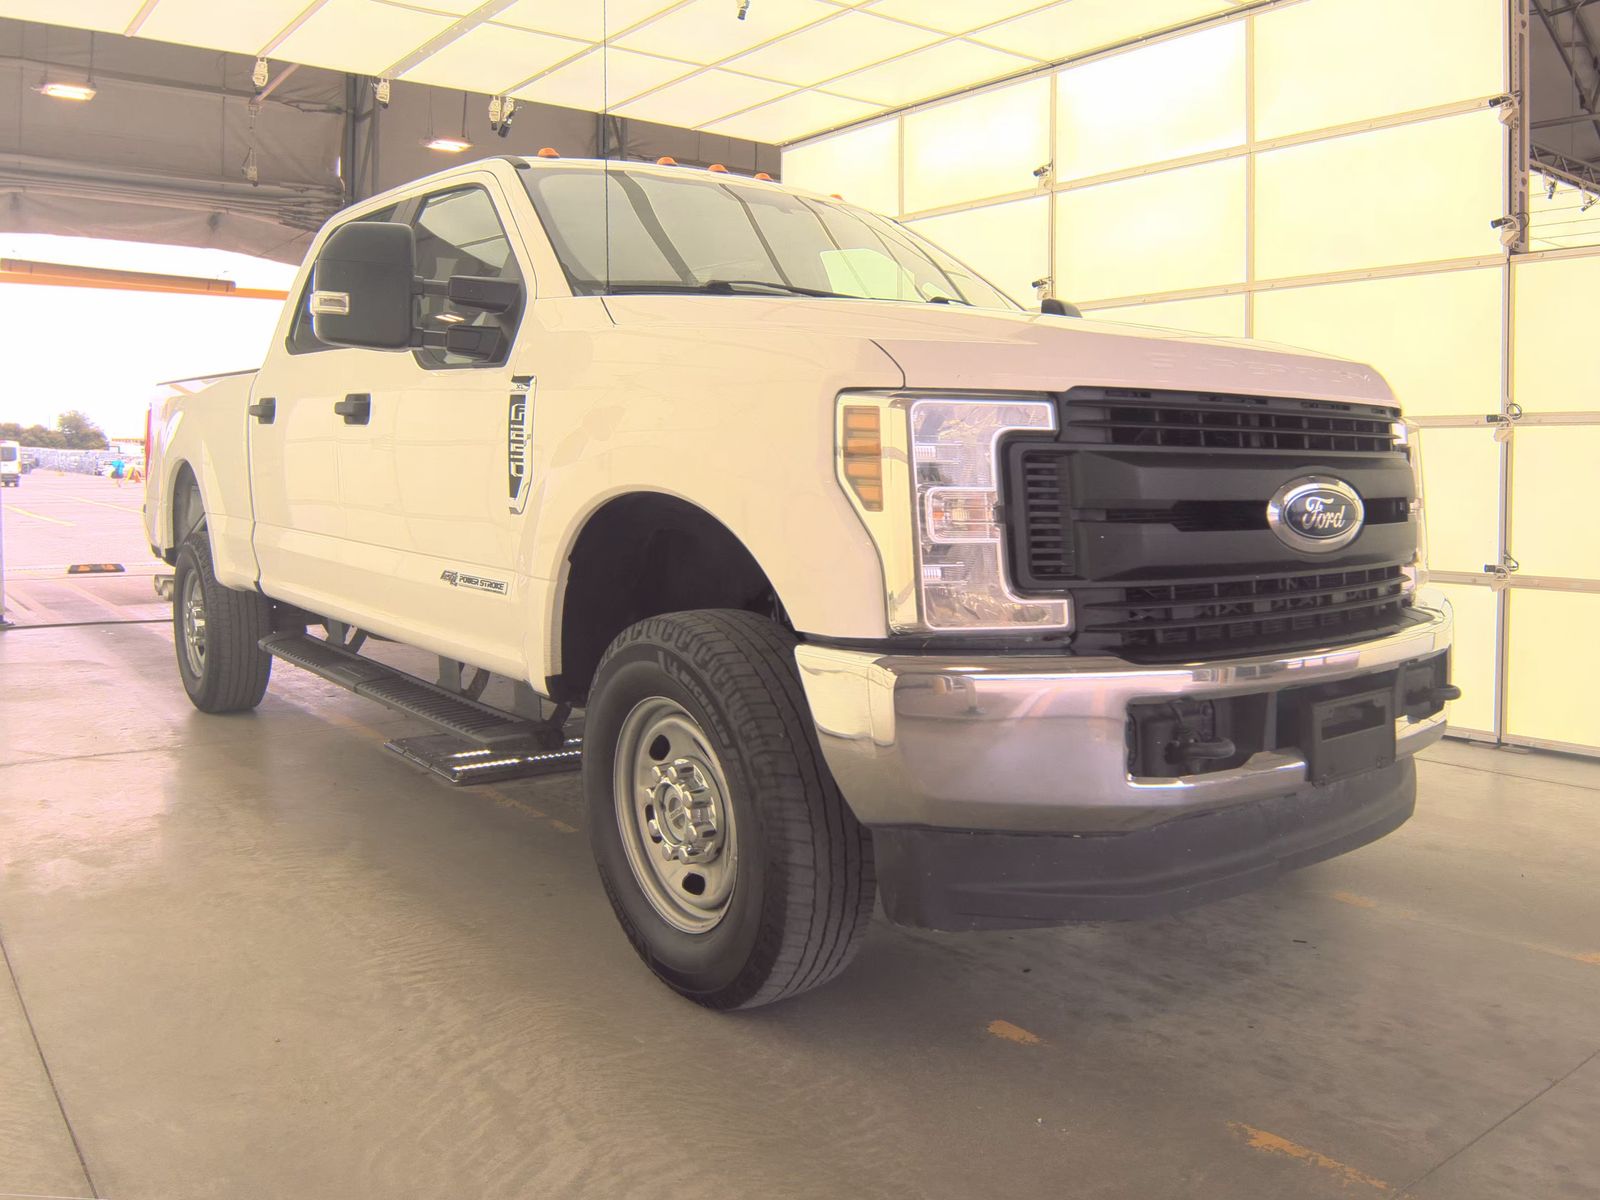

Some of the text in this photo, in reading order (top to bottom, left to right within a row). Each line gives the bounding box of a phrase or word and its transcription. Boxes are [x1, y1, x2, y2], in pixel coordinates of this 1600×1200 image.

[1302, 496, 1346, 529] Ford
[459, 575, 479, 586] POWER
[479, 579, 504, 591] STROKE
